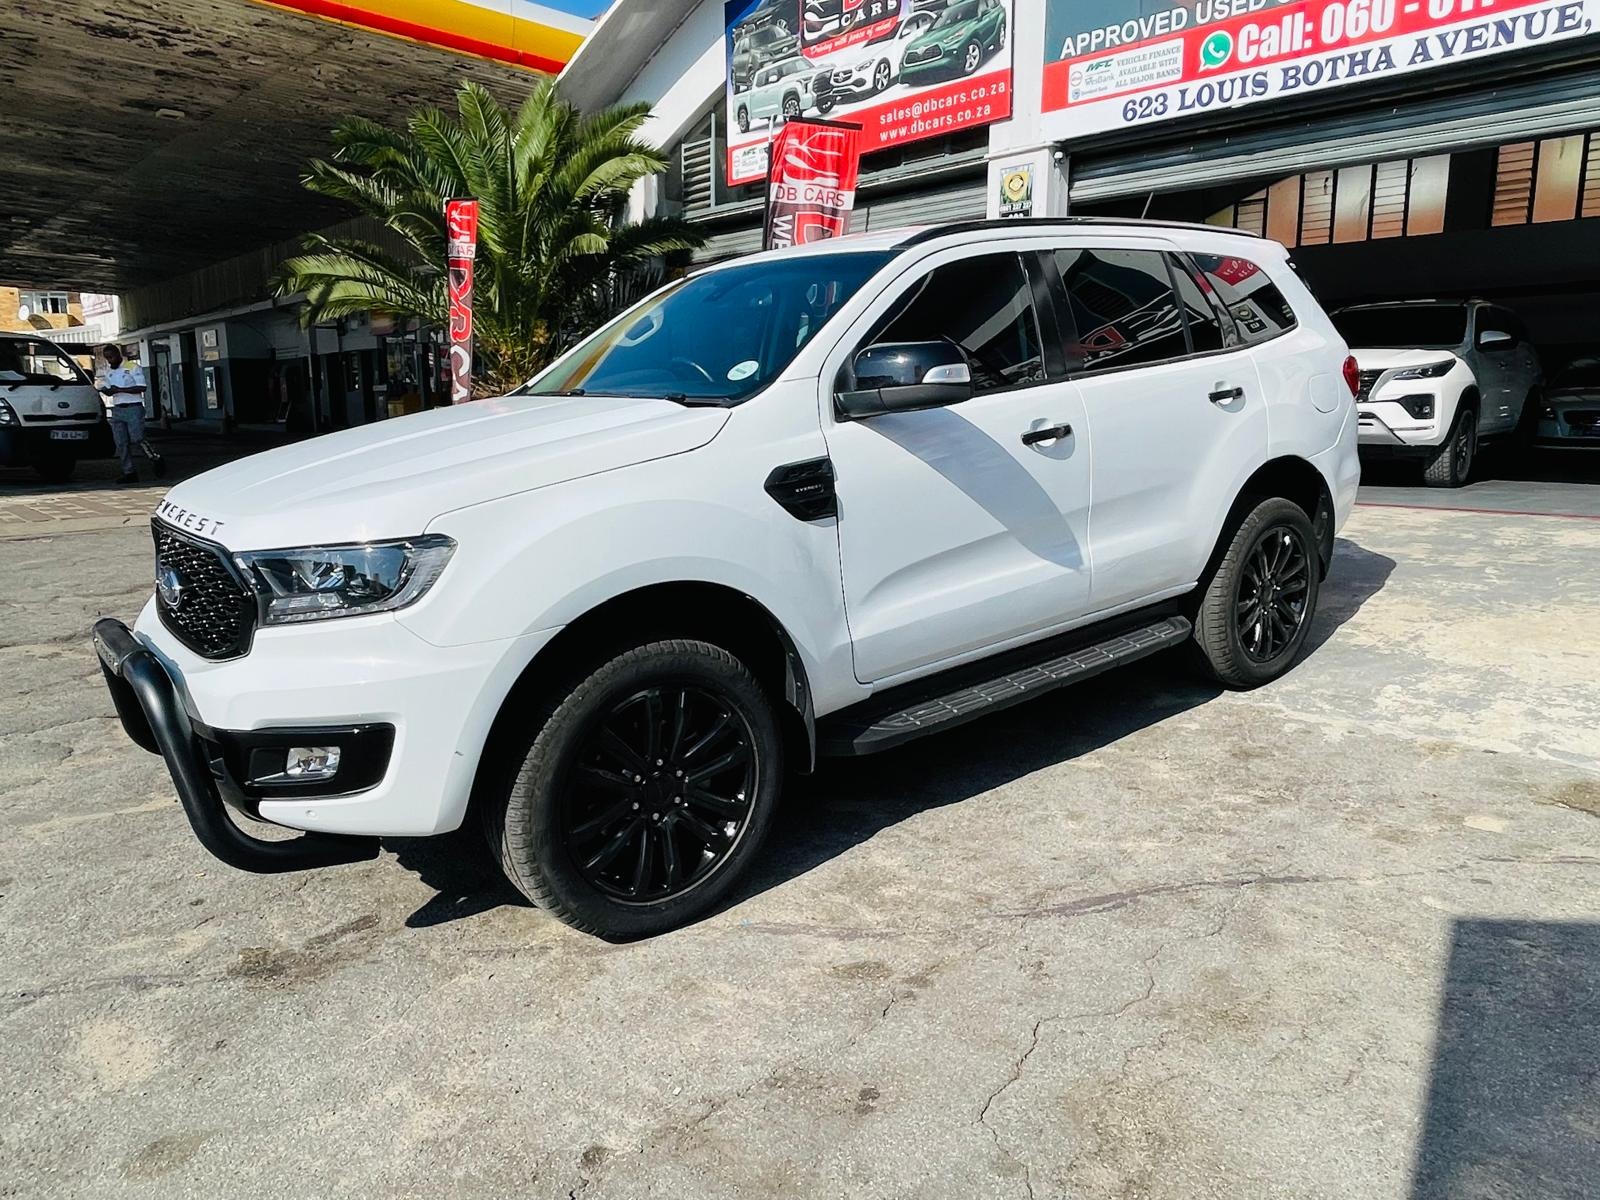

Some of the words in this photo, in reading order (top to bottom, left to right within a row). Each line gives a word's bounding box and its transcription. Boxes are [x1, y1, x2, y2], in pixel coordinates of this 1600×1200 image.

[1060, 5, 1188, 60] APPROVED
[1238, 11, 1313, 63] Call:
[1320, 0, 1397, 45] 060
[1118, 61, 1157, 77] AVAILABLE
[1158, 57, 1178, 68] WITH
[1122, 93, 1168, 122] 623
[1177, 71, 1269, 111] LOUIS
[1279, 44, 1397, 92] BOTHA
[1407, 1, 1592, 66] AVENUE,
[1148, 45, 1181, 60] FINANCE
[1114, 79, 1128, 88] ALL
[1155, 66, 1181, 79] BANKS
[879, 81, 1005, 125] sales@dbcars.co.za
[879, 104, 991, 142] www.dbcars.co.za
[775, 185, 797, 201] DB
[803, 187, 845, 208] CARS
